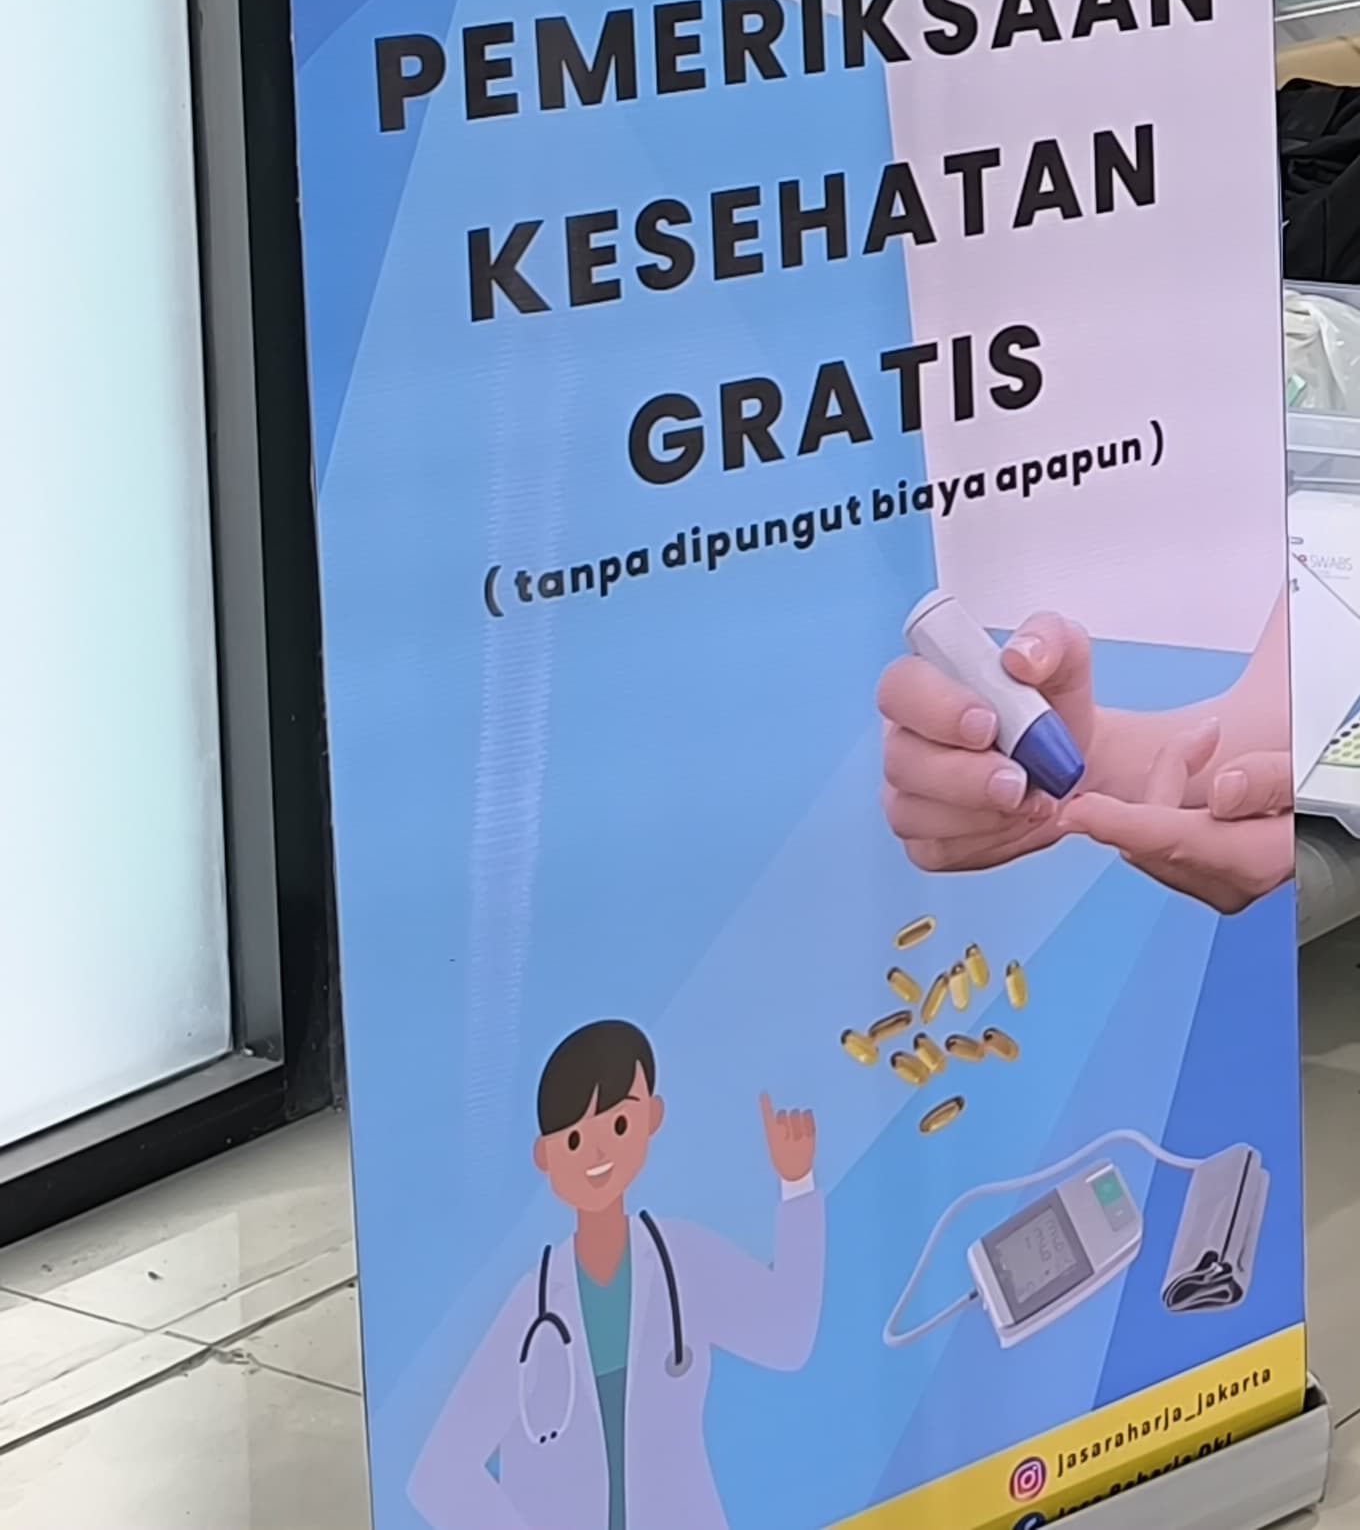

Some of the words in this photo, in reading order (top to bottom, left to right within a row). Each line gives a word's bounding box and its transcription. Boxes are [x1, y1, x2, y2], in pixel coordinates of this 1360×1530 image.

[467, 123, 1157, 322] KESEHATAN
[627, 324, 1043, 486] GRATIS
[661, 495, 862, 571] dipungut
[872, 472, 986, 522] biaya
[1057, 1368, 1272, 1478] jasaraharja_jakarta
